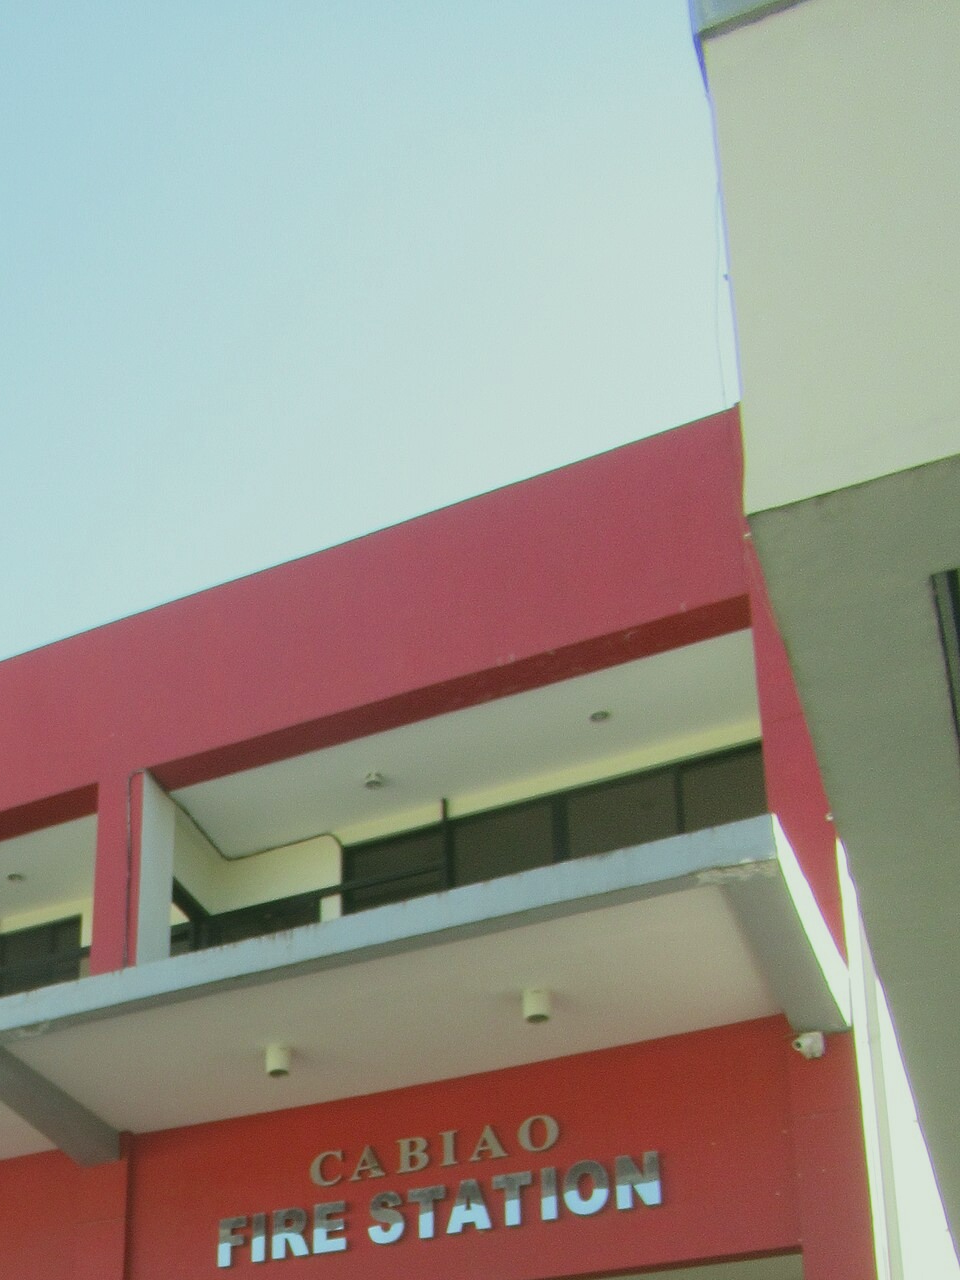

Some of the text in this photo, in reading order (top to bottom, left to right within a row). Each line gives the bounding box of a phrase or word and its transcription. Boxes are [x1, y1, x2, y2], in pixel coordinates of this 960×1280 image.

[309, 1114, 560, 1187] CABIAO
[217, 1150, 662, 1268] FIRE STATION
